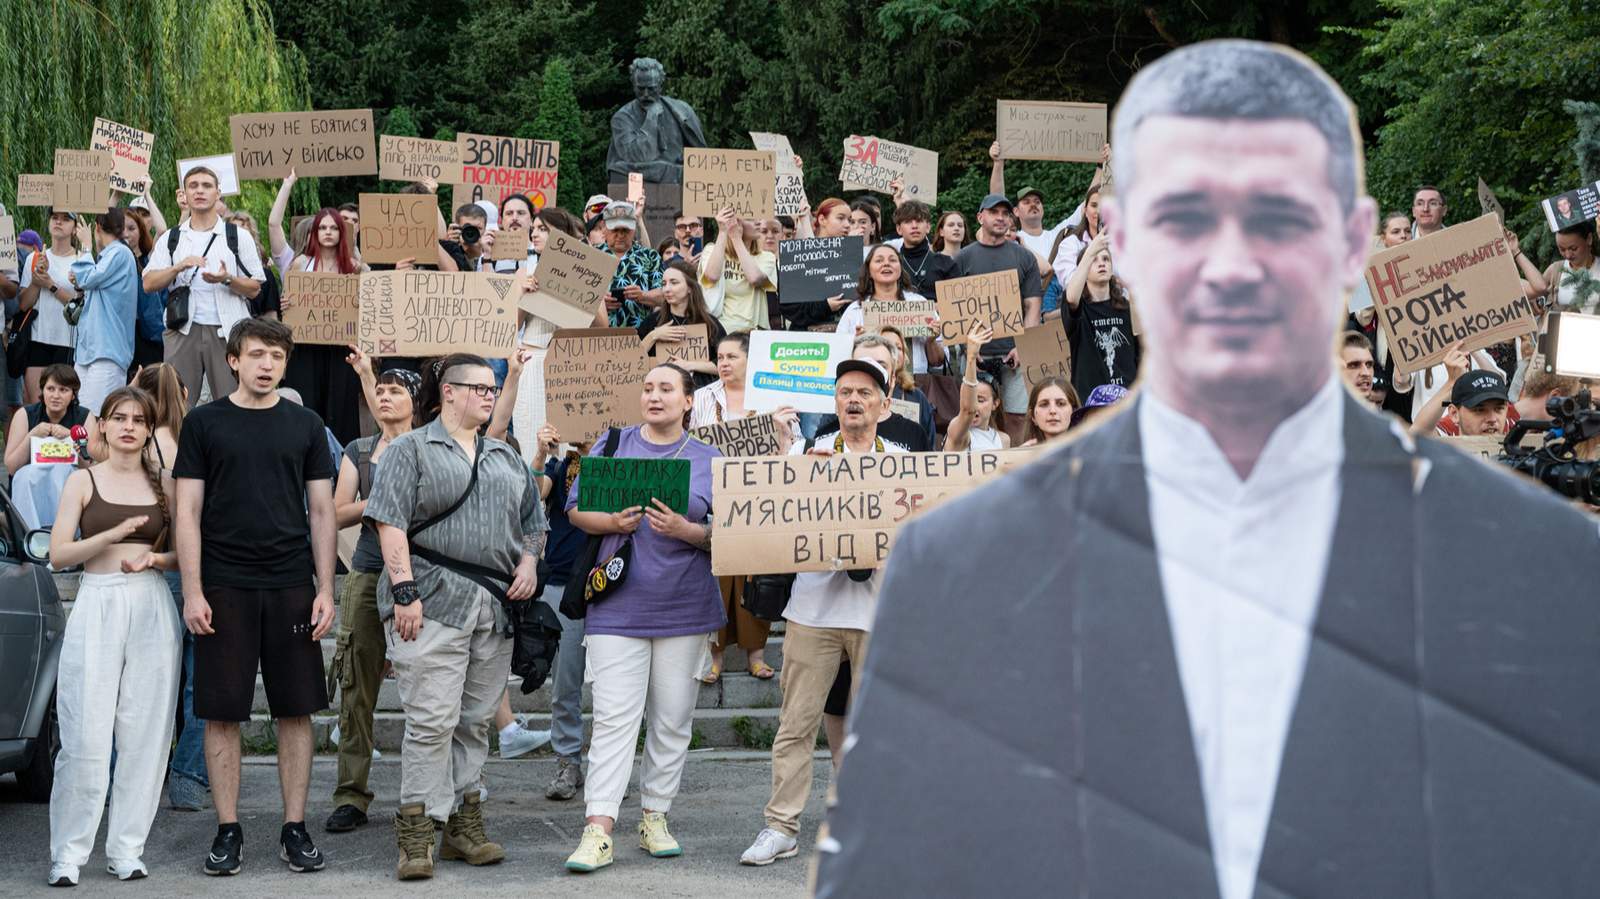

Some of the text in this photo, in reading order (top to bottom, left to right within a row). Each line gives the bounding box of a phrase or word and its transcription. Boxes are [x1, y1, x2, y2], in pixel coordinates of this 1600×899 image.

[96, 128, 152, 152] ПРИДАТНОСТІ
[97, 119, 144, 141] ТЕРМІН
[241, 118, 368, 142] ХОЧУ НЕ БОЯТИСЯ
[240, 143, 365, 169] ЙТИ У ВІЙСЬКО
[463, 137, 558, 169] ЗВІЛЬНІТЬ
[687, 154, 728, 172] СИРА
[736, 154, 773, 172] ГЕТЬ!
[846, 136, 879, 167] ЗА
[402, 162, 442, 179] НІХТО
[462, 166, 559, 190] ПОЛОНЕНИХ
[842, 169, 893, 190] ТЕХНОЛОГ
[472, 184, 484, 205] А
[686, 180, 753, 203] ФЕДОРА
[777, 186, 803, 196] КОМУ
[380, 197, 424, 225] ЧАС
[549, 237, 586, 261] Якого
[779, 240, 801, 254] МОЯ
[550, 267, 567, 279] ти
[571, 263, 603, 288] народу
[1369, 238, 1508, 306] НЕ ЗАКРИВАЙТЕ
[404, 273, 467, 296] ПРОТИ
[943, 274, 1019, 299] ПОВЕРНІТЬ
[307, 309, 339, 323] А НЕ
[360, 276, 378, 338] ФЕДОРОВ
[378, 274, 397, 337] СИРСЬКИЙ
[404, 297, 492, 317] ЛИПНЕВОГО
[952, 295, 1000, 317] ТОНІ
[1385, 283, 1468, 337] РОТА
[878, 314, 923, 326] ІНФАРКТ
[941, 310, 1024, 340] СТАРКА
[1397, 296, 1532, 363] ВІЙСЬКОВИМ
[404, 318, 517, 348] ЗАГОСТРЕННЯ
[687, 335, 705, 347] ТУТ
[554, 338, 584, 359] МИ
[665, 344, 709, 362] ЖИТИ
[775, 346, 825, 358] Досить!
[780, 362, 820, 373] Сунути
[605, 373, 647, 387] ФЕДОРО
[1471, 376, 1499, 388] NEW YORK
[688, 413, 777, 447] ВІЛЬНЕНН
[718, 433, 780, 457] ОРОВА
[722, 460, 796, 489] ГЕТЬ
[809, 453, 998, 484] МАРОДЕРІВ
[794, 532, 857, 565] ВІД
